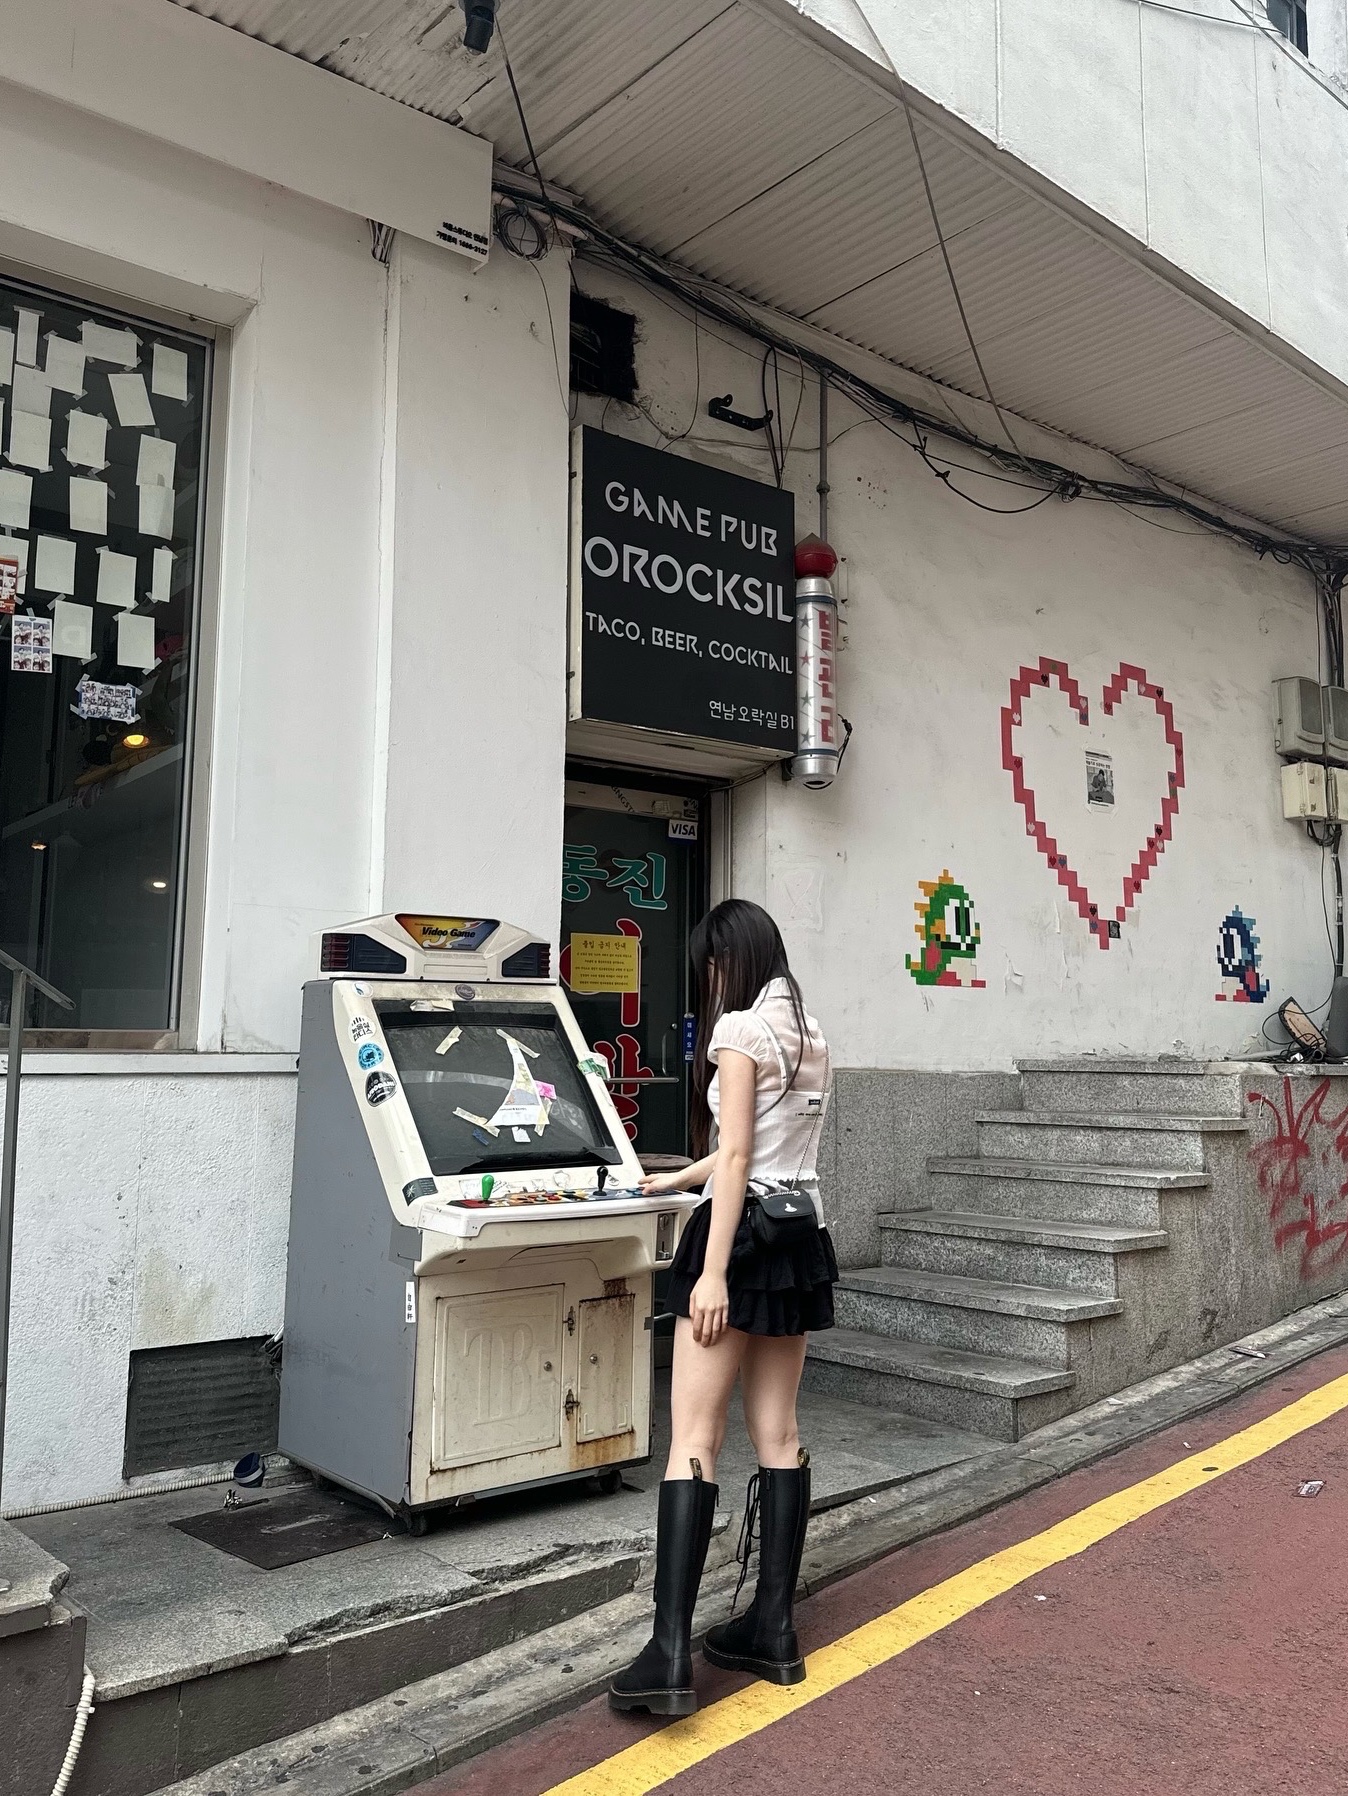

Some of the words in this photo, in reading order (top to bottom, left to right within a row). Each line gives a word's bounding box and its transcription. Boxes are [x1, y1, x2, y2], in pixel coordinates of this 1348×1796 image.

[604, 480, 712, 539] GAME
[720, 513, 778, 557] PUB
[584, 535, 794, 624] OROCKSIL
[585, 610, 646, 646] TACO,
[651, 627, 703, 658] BEER,
[707, 639, 794, 676] COCKTAIL
[780, 714, 795, 730] B1
[671, 823, 697, 837] VISA
[562, 843, 668, 911] 동진
[421, 926, 449, 937] Video
[450, 928, 477, 938] Game
